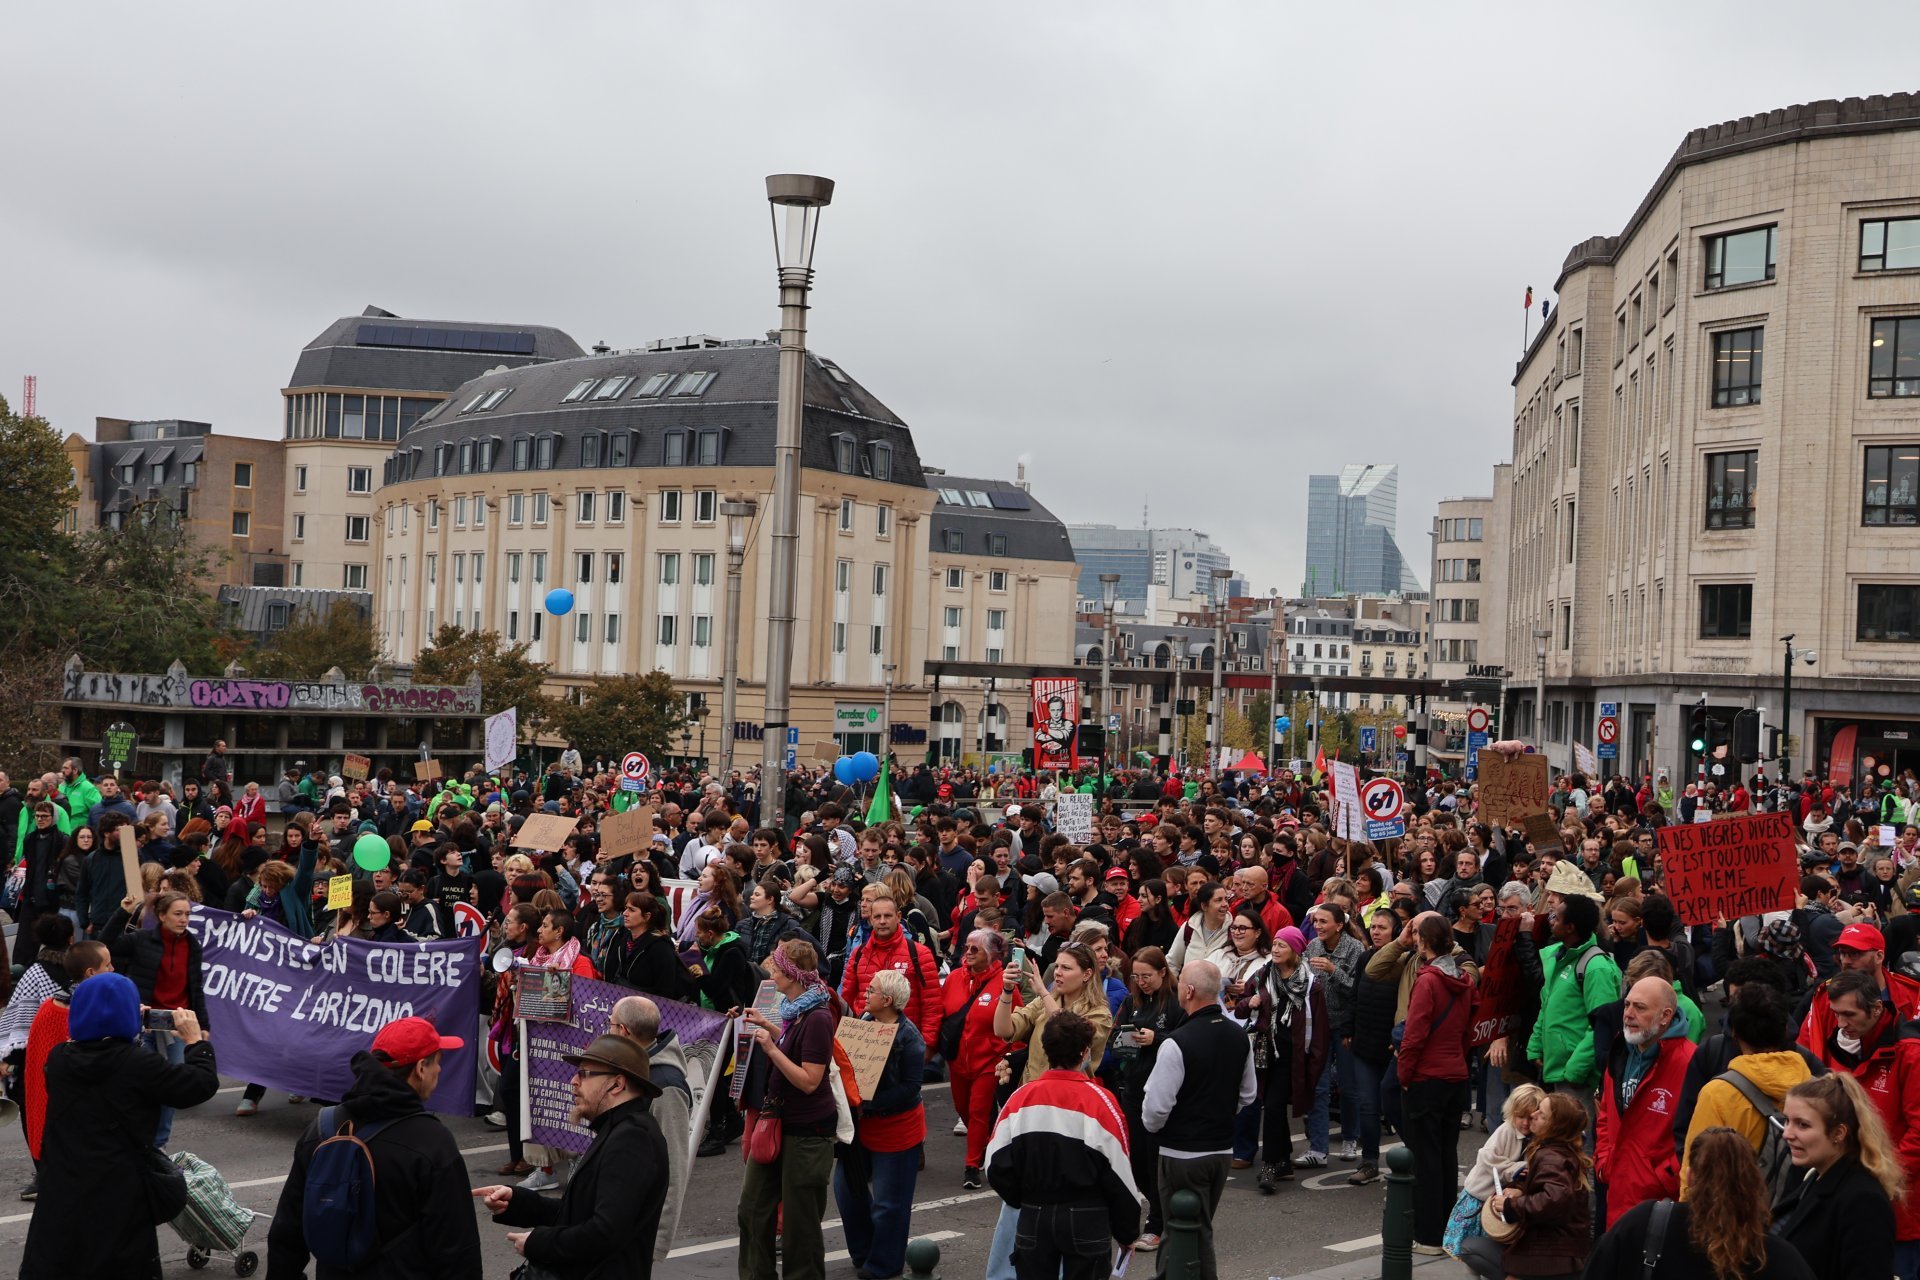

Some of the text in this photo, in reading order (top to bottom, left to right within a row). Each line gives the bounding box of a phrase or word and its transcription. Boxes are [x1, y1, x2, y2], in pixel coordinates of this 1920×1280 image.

[1034, 680, 1075, 704] GEDAAN
[837, 709, 865, 719] Carrefour
[787, 751, 795, 763] P
[626, 761, 643, 773] 67
[1466, 767, 1474, 778] P
[1369, 790, 1395, 811] 67
[1673, 828, 1693, 851] DES
[1748, 815, 1791, 841] DIVERS
[1670, 869, 1747, 897] LA MEME
[1678, 876, 1785, 922] EXPLOITATION
[321, 942, 347, 974] EN
[1472, 1018, 1497, 1041] STOP
[529, 1048, 549, 1059] FROM
[549, 1080, 560, 1090] ARE
[536, 1098, 566, 1110] RELIGIOUS
[533, 1107, 541, 1116] OF
[543, 1109, 562, 1119] WHICH
